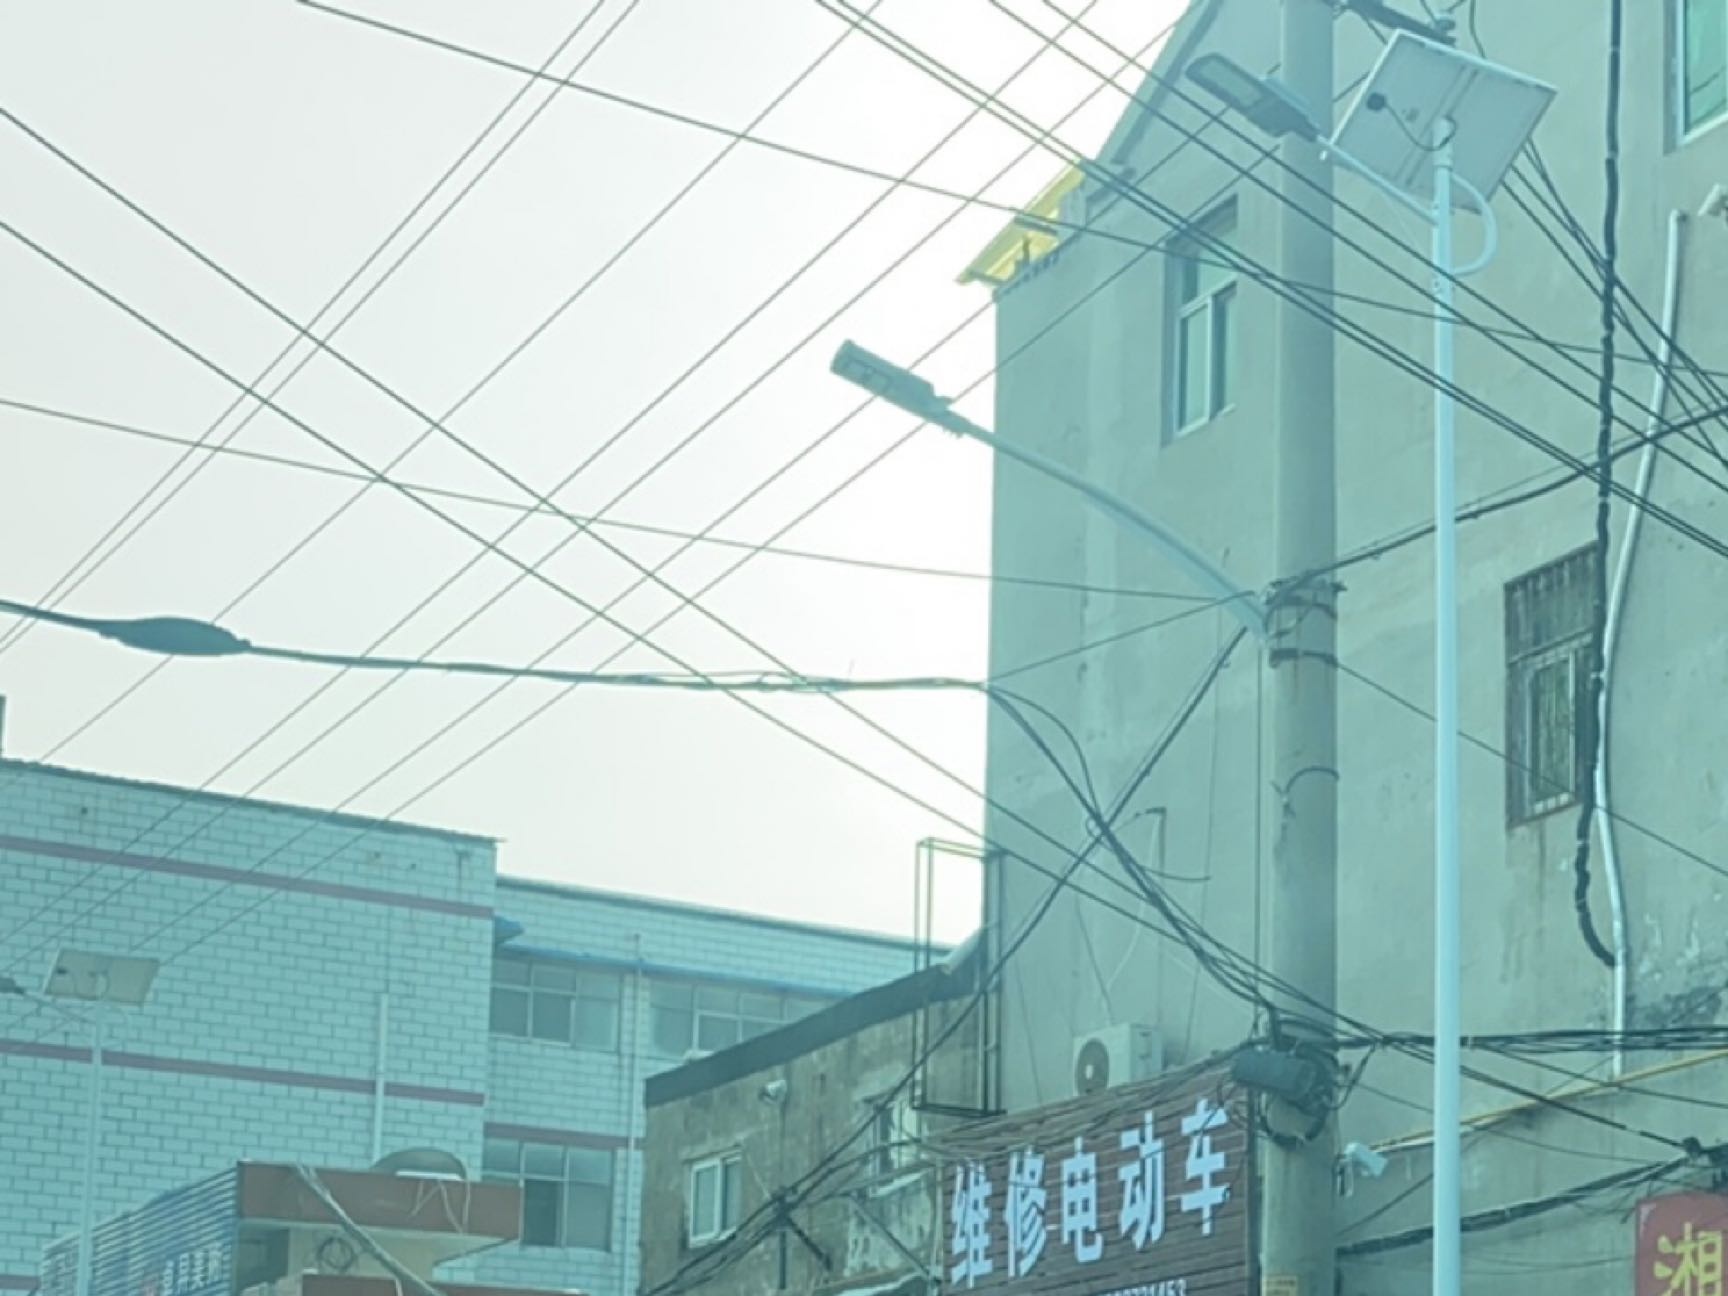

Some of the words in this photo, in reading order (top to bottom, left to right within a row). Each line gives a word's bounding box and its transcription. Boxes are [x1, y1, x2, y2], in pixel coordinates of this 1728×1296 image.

[951, 1098, 1230, 1290] 维修电动车
